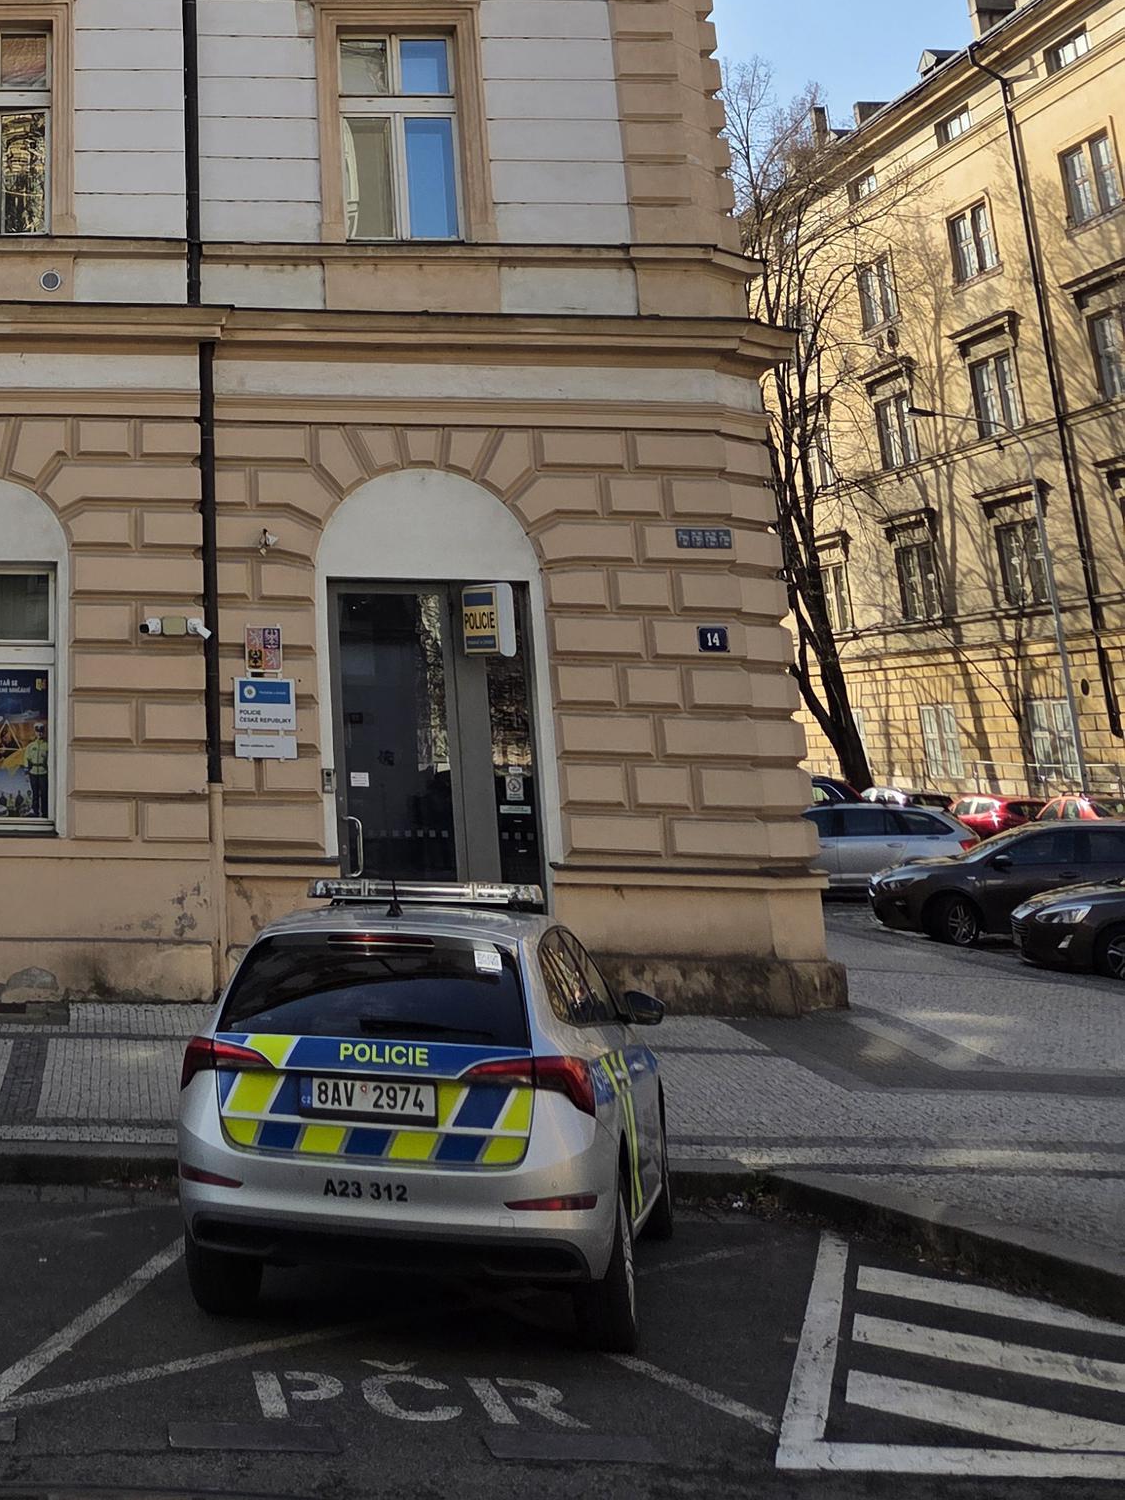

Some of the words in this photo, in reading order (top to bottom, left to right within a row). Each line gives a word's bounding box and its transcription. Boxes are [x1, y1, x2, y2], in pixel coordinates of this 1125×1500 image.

[464, 612, 495, 629] POLICIE
[707, 632, 720, 646] 14
[339, 1043, 429, 1067] POLICIE
[317, 1081, 355, 1107] 8AV
[372, 1084, 425, 1113] 2974
[323, 1178, 362, 1198] A23
[369, 1182, 408, 1202] 312
[252, 1358, 591, 1429] PČR
